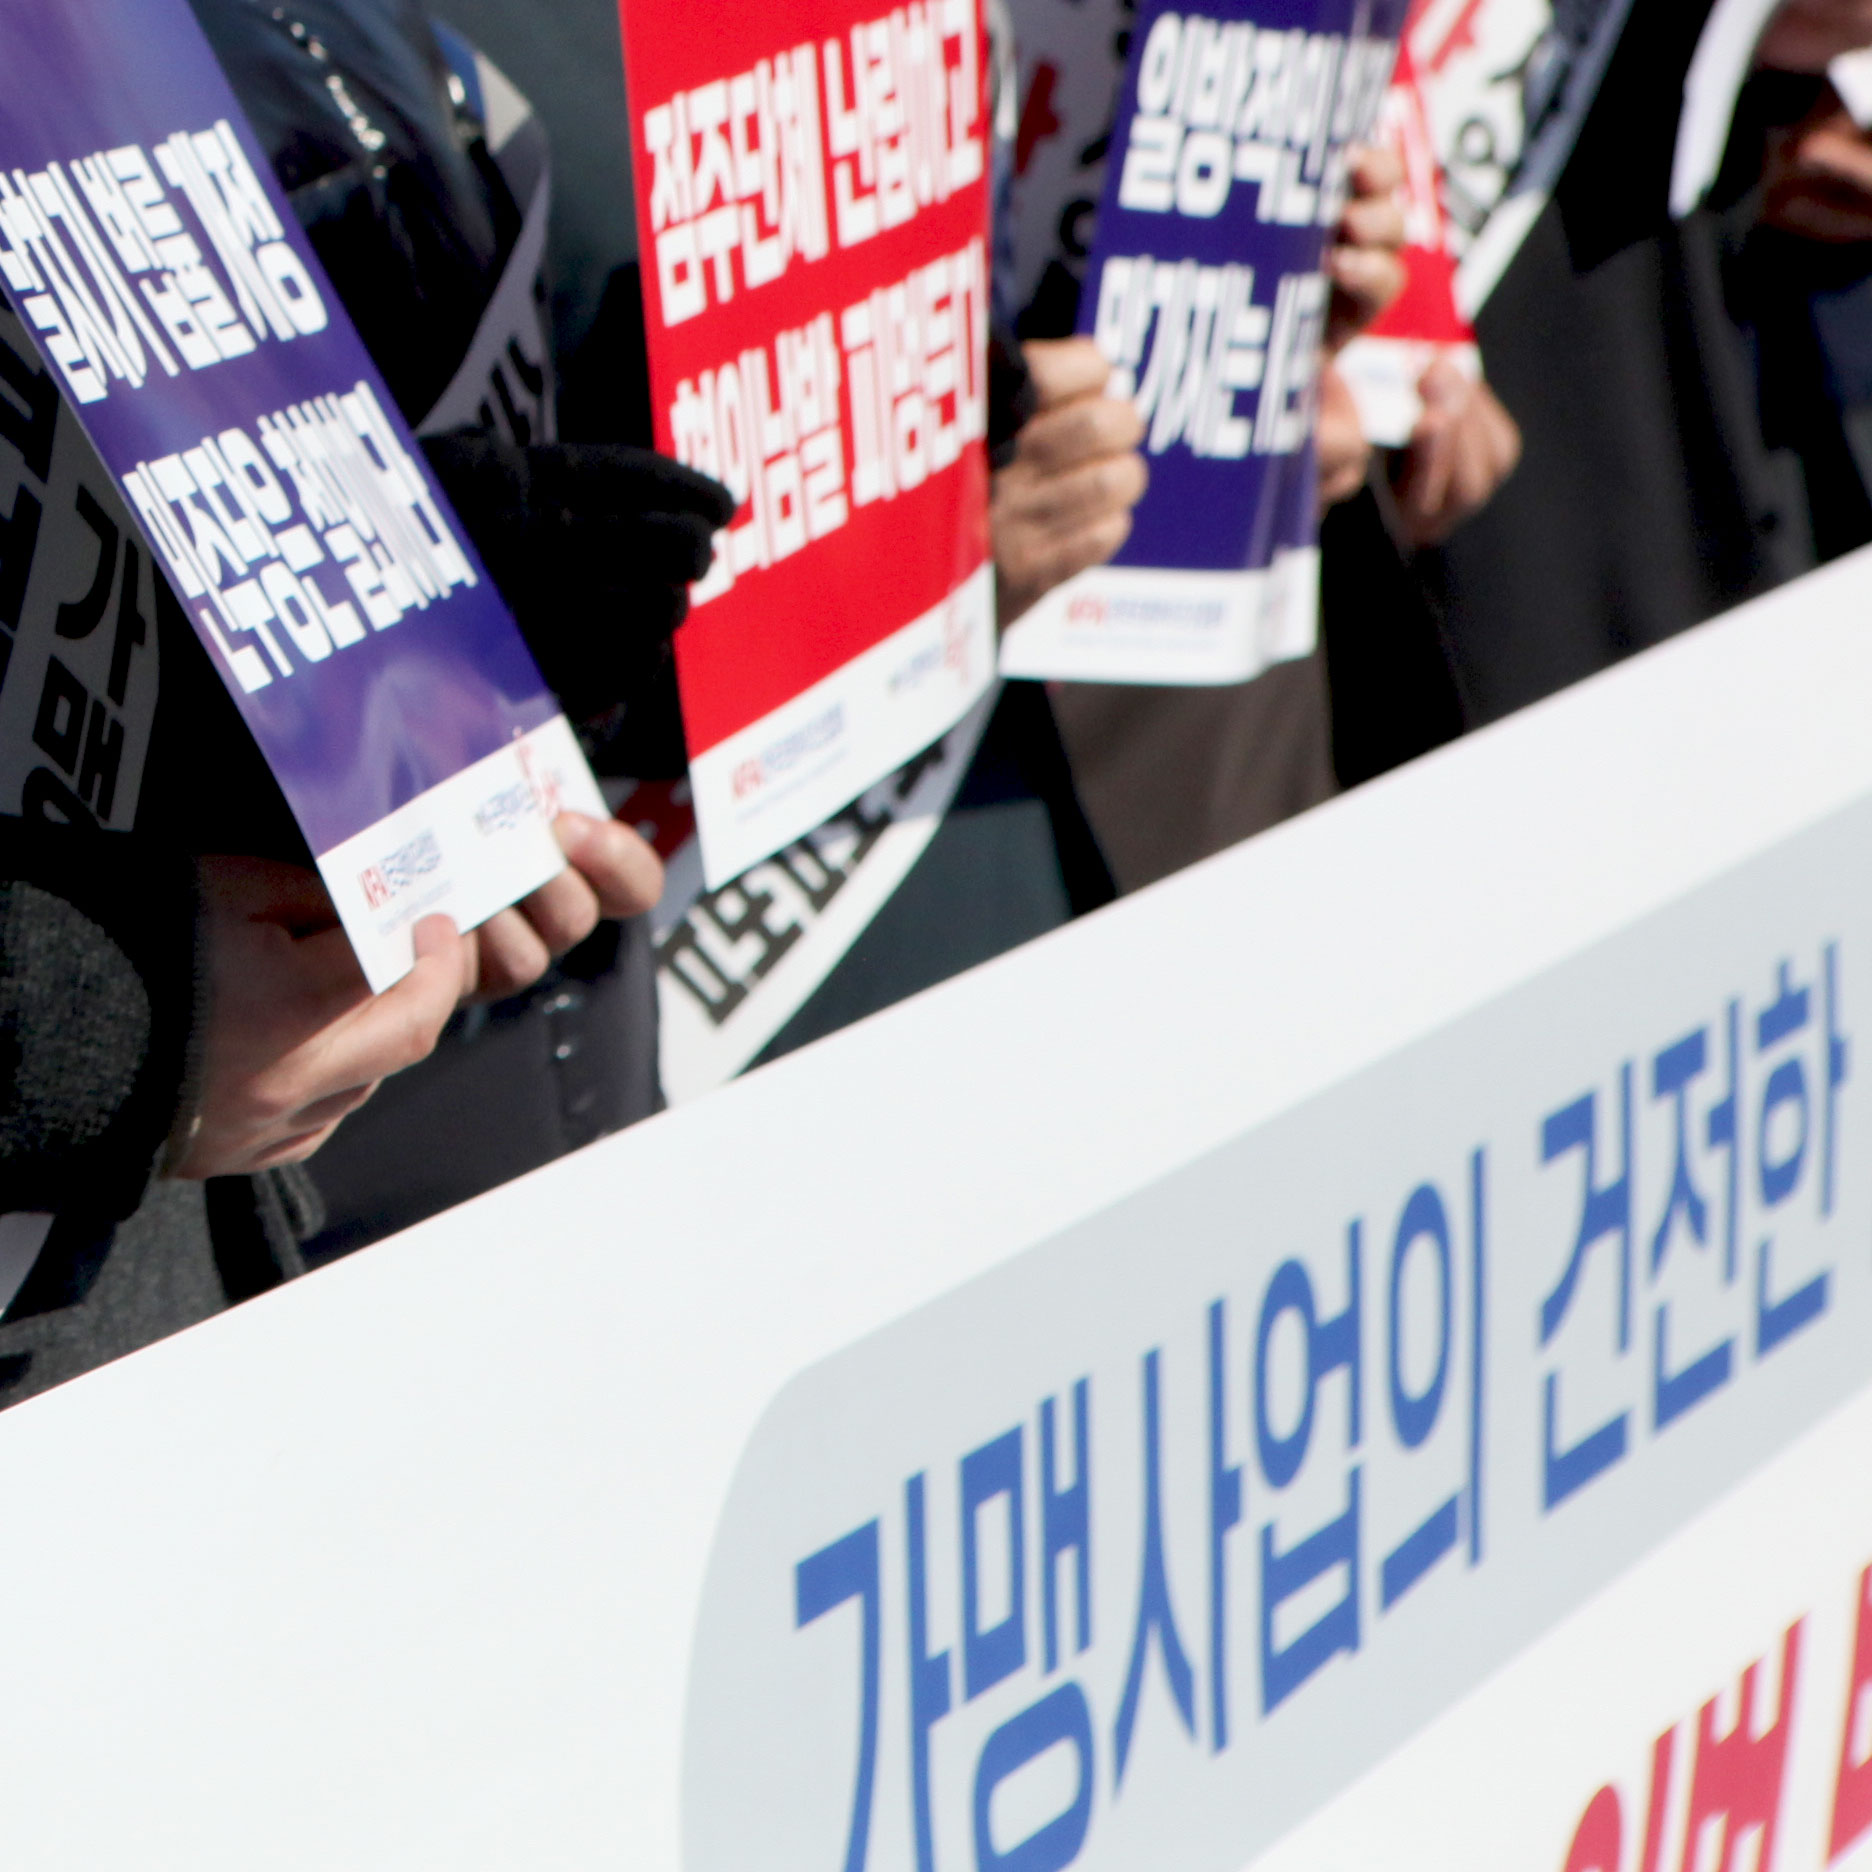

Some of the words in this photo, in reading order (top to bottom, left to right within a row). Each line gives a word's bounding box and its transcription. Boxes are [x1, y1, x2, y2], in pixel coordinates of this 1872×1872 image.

[153, 119, 329, 342] 개정
[643, 40, 830, 328] 점주단체
[1118, 10, 1351, 228] 일방적인
[70, 143, 257, 370] 법률
[121, 427, 368, 695] 민주당은
[256, 379, 479, 633] 철회하라
[792, 1144, 1487, 1872] 가맹사업의
[1537, 939, 1849, 1521] 건전한
